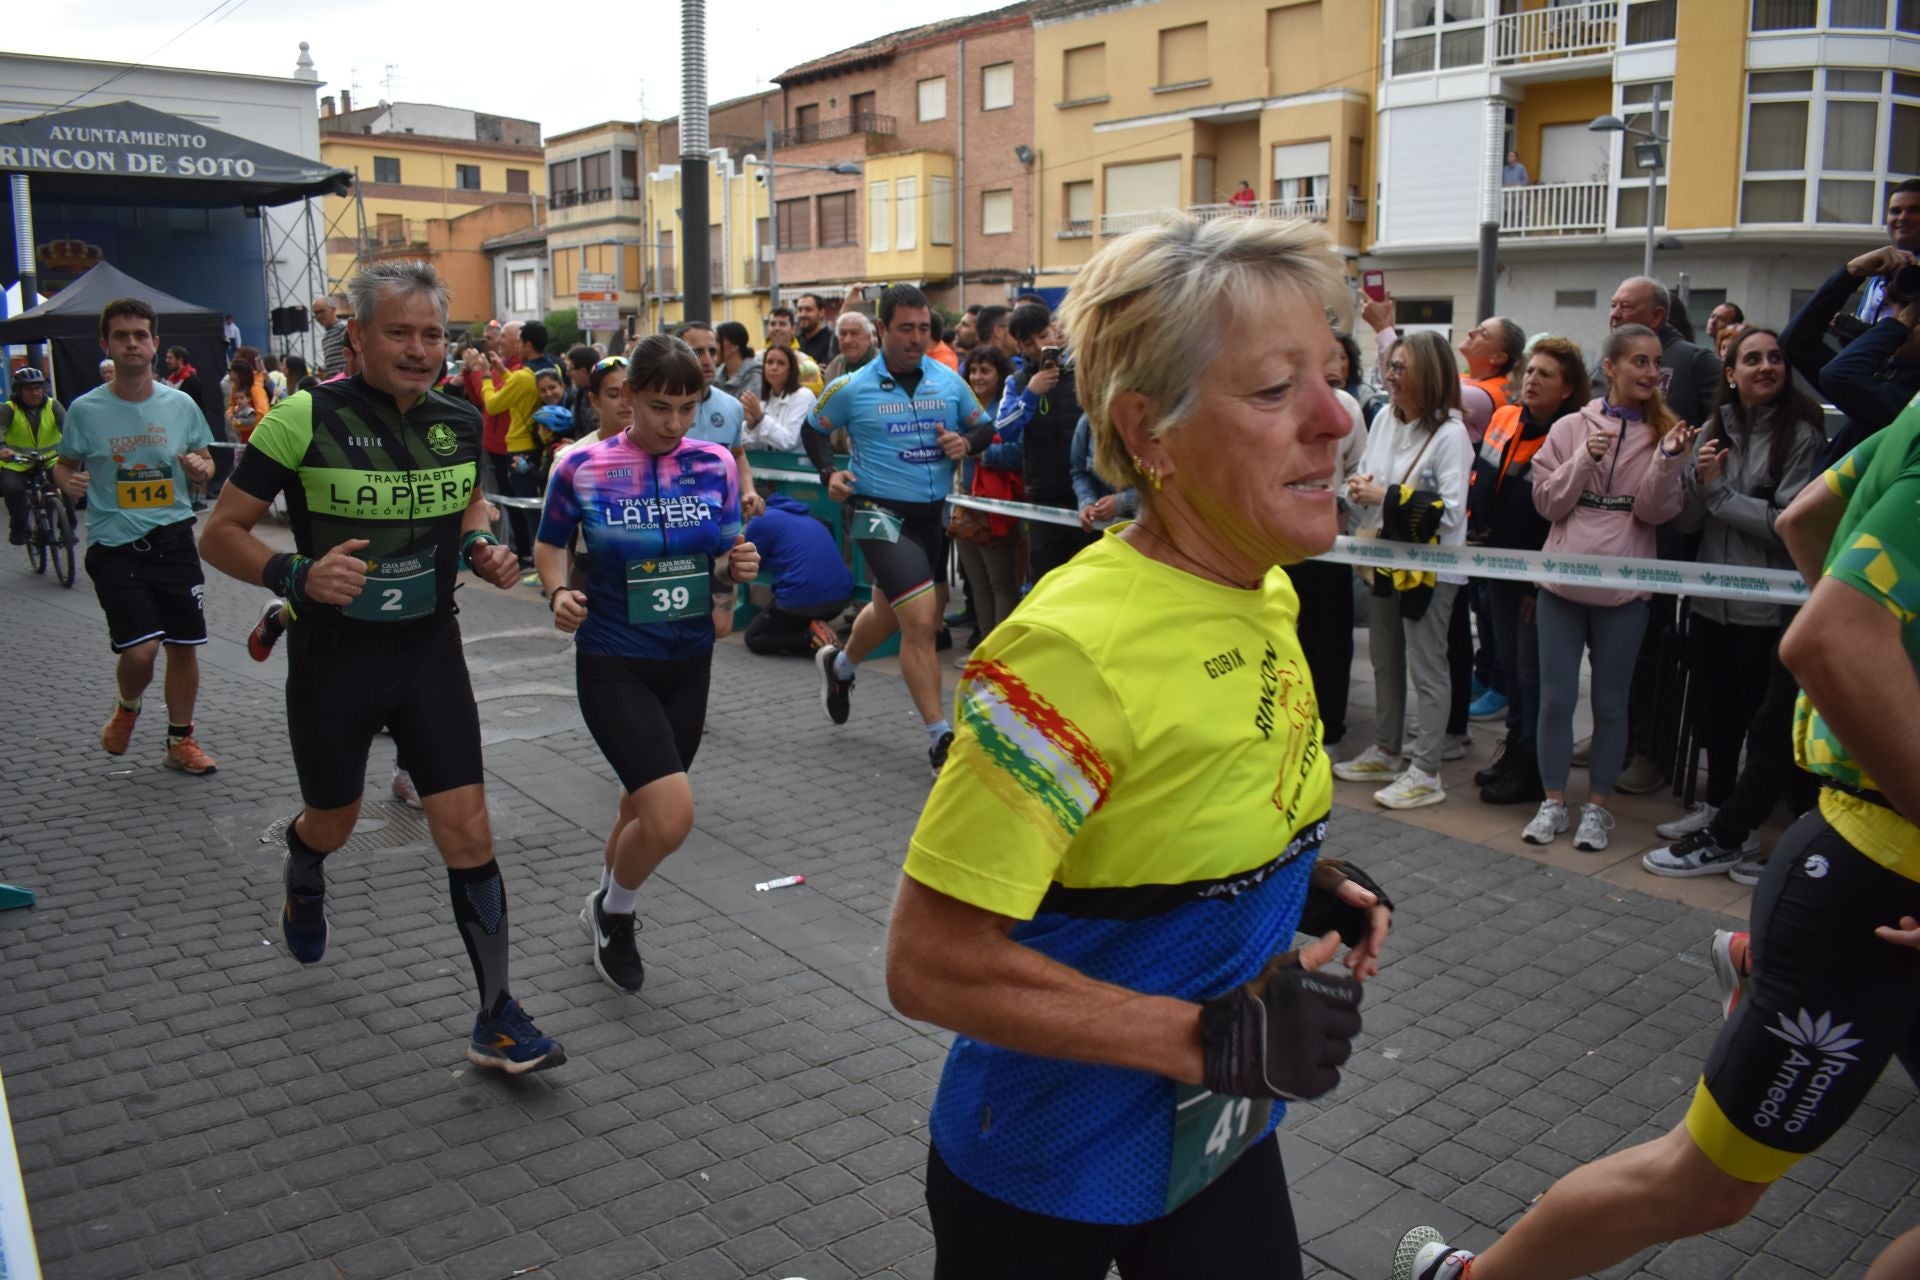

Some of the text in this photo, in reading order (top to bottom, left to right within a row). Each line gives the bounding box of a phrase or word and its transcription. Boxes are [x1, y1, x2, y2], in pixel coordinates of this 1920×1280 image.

[49, 126, 206, 149] AYUNTAMIENTO
[0, 146, 255, 178] RINCON DE SOTO
[908, 399, 946, 412] SPORTS
[348, 436, 383, 448] GOBIK
[366, 469, 454, 484] TRAVESIA BTT
[606, 469, 633, 479] GOBIK
[126, 485, 167, 502] 114
[330, 477, 472, 506] LA PERA
[617, 495, 699, 507] TRAVESIA BTT
[330, 504, 404, 516] RINCÓN
[415, 506, 432, 515] DE
[606, 503, 712, 526] LA PERA
[678, 520, 701, 528] SOTO
[870, 518, 881, 532] 7
[380, 588, 403, 611] 2
[652, 586, 690, 612] 39
[1203, 647, 1247, 680] GOBIK
[1255, 640, 1278, 741] RINCON
[1753, 1048, 1812, 1128] Arnedo
[1784, 1058, 1847, 1133] Ramiro
